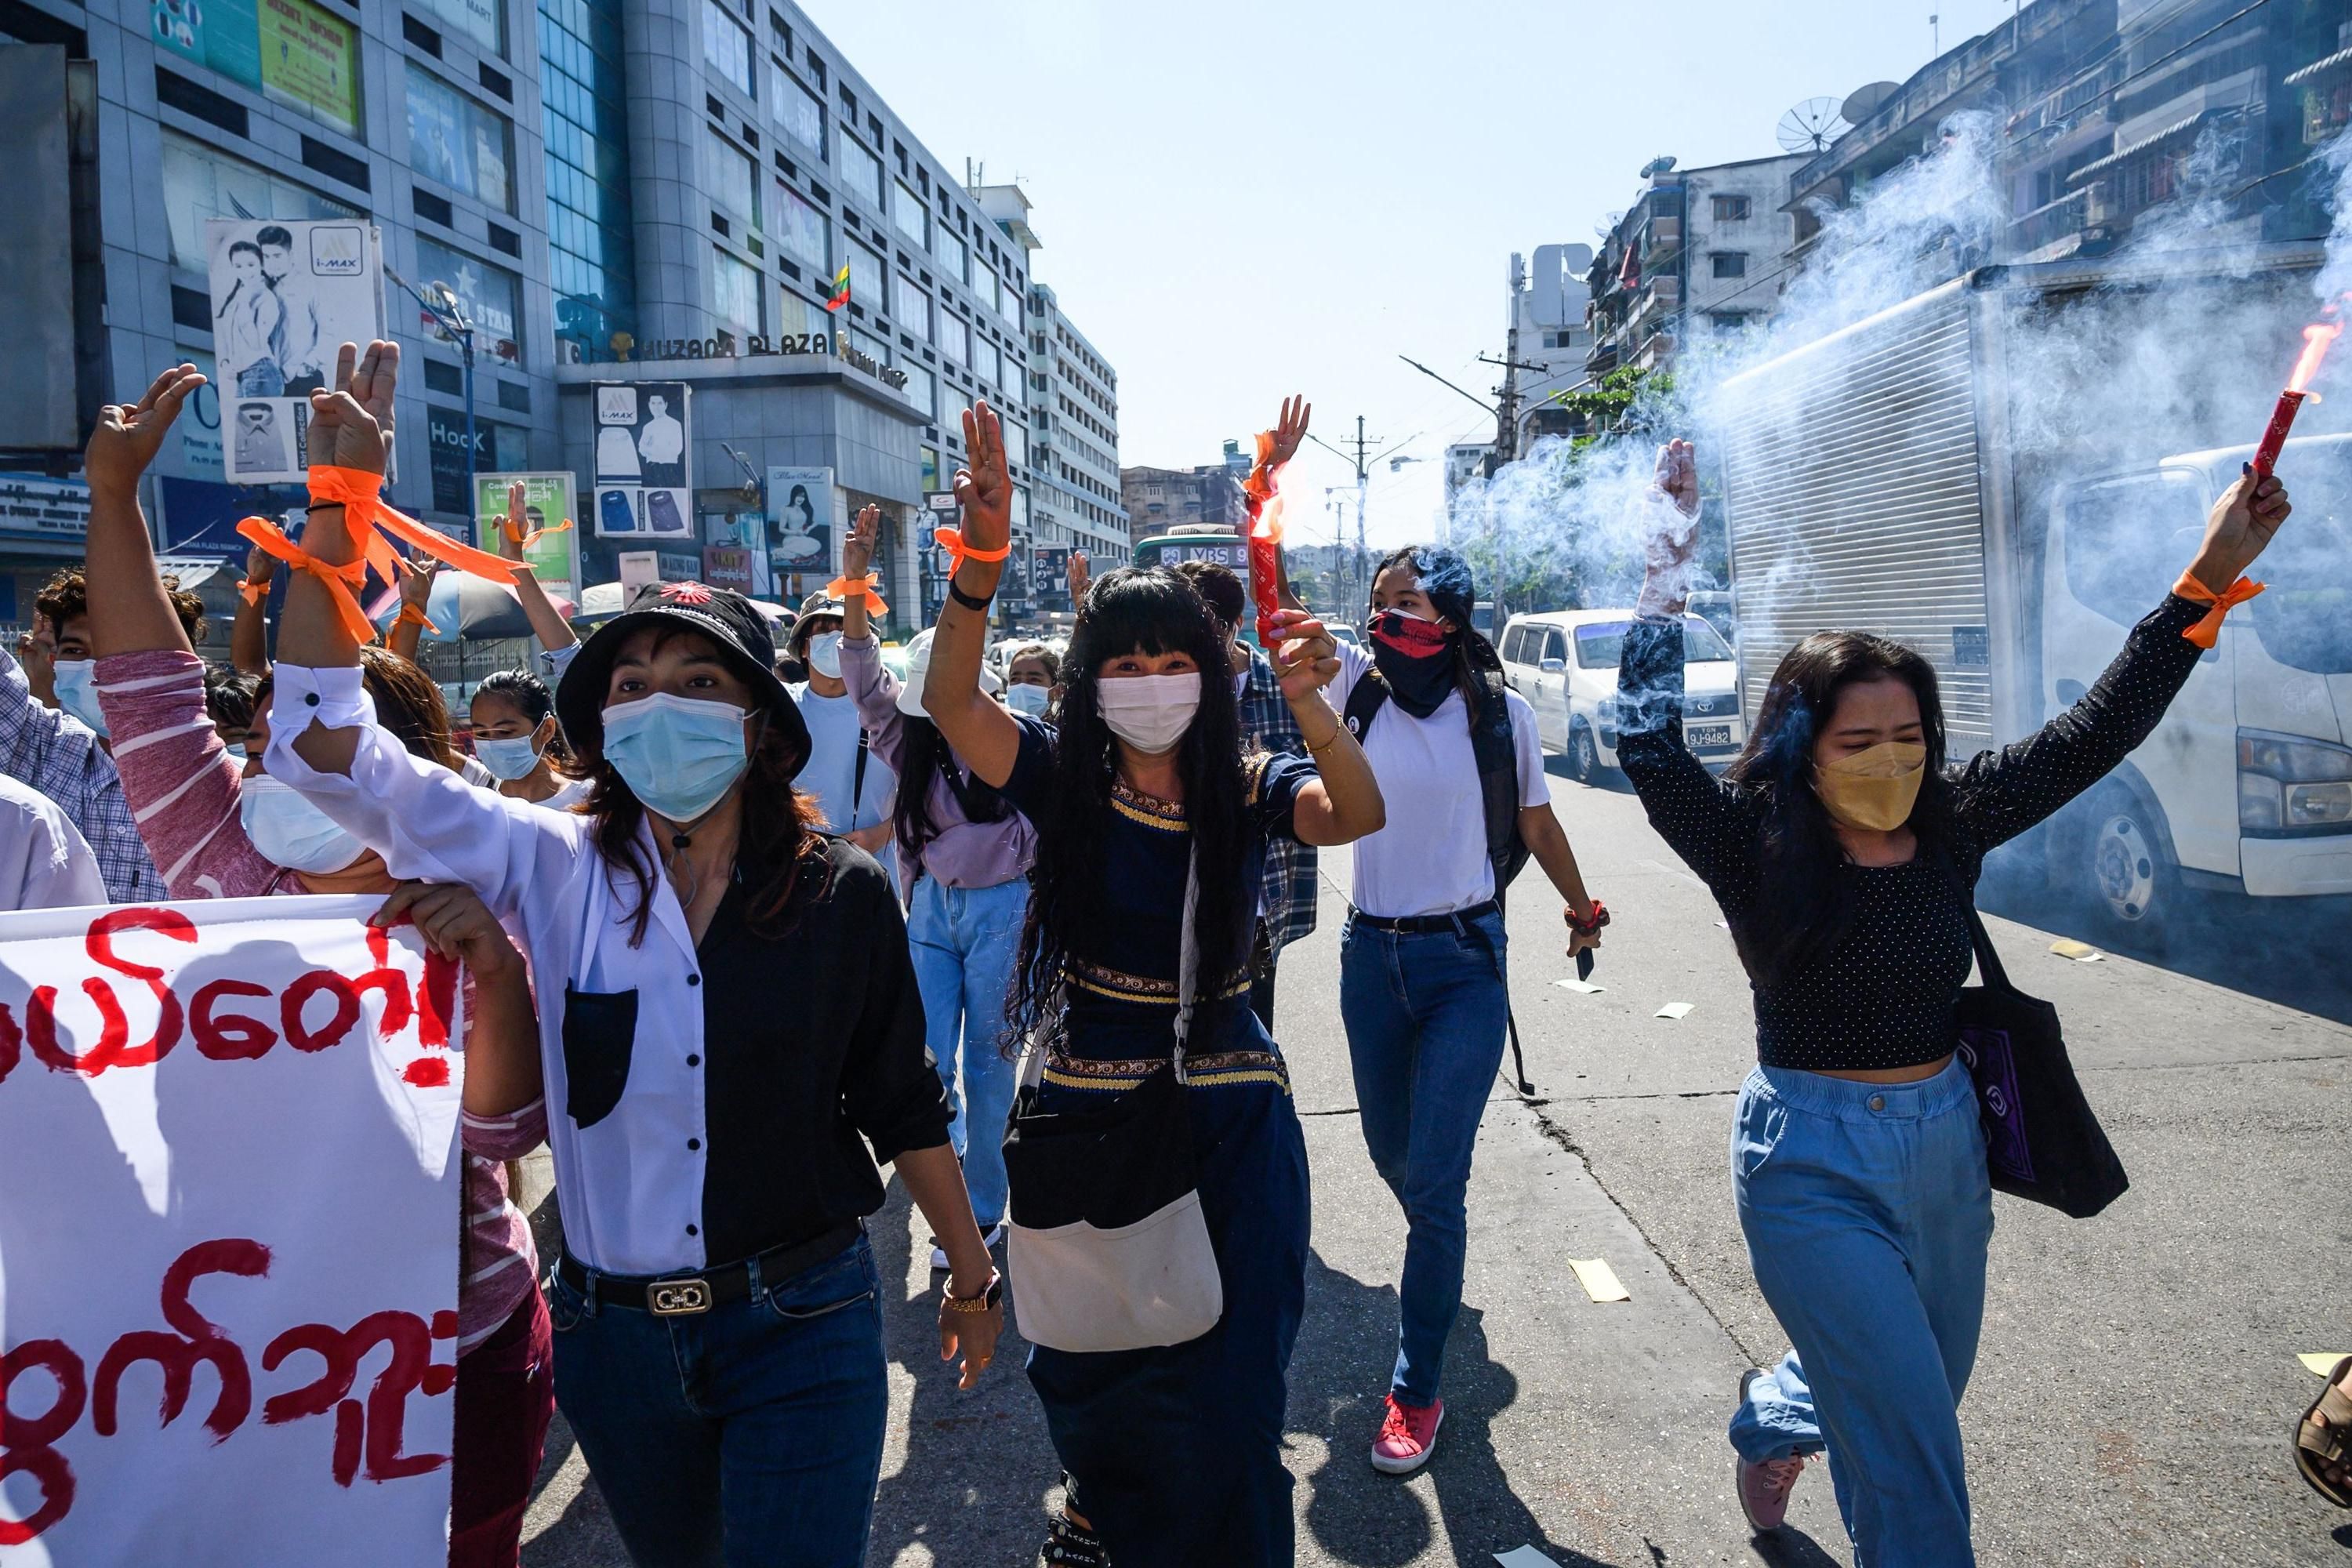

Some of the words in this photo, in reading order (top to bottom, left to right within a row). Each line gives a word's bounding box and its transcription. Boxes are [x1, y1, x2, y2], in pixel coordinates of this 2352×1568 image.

[316, 258, 357, 267] i-MAX
[476, 303, 513, 335] STAR
[748, 333, 827, 356] PLAZA
[297, 405, 307, 449] Collection
[1194, 549, 1227, 563] YBS
[1237, 549, 1247, 562] 9
[1690, 731, 1729, 745] 9J-9482
